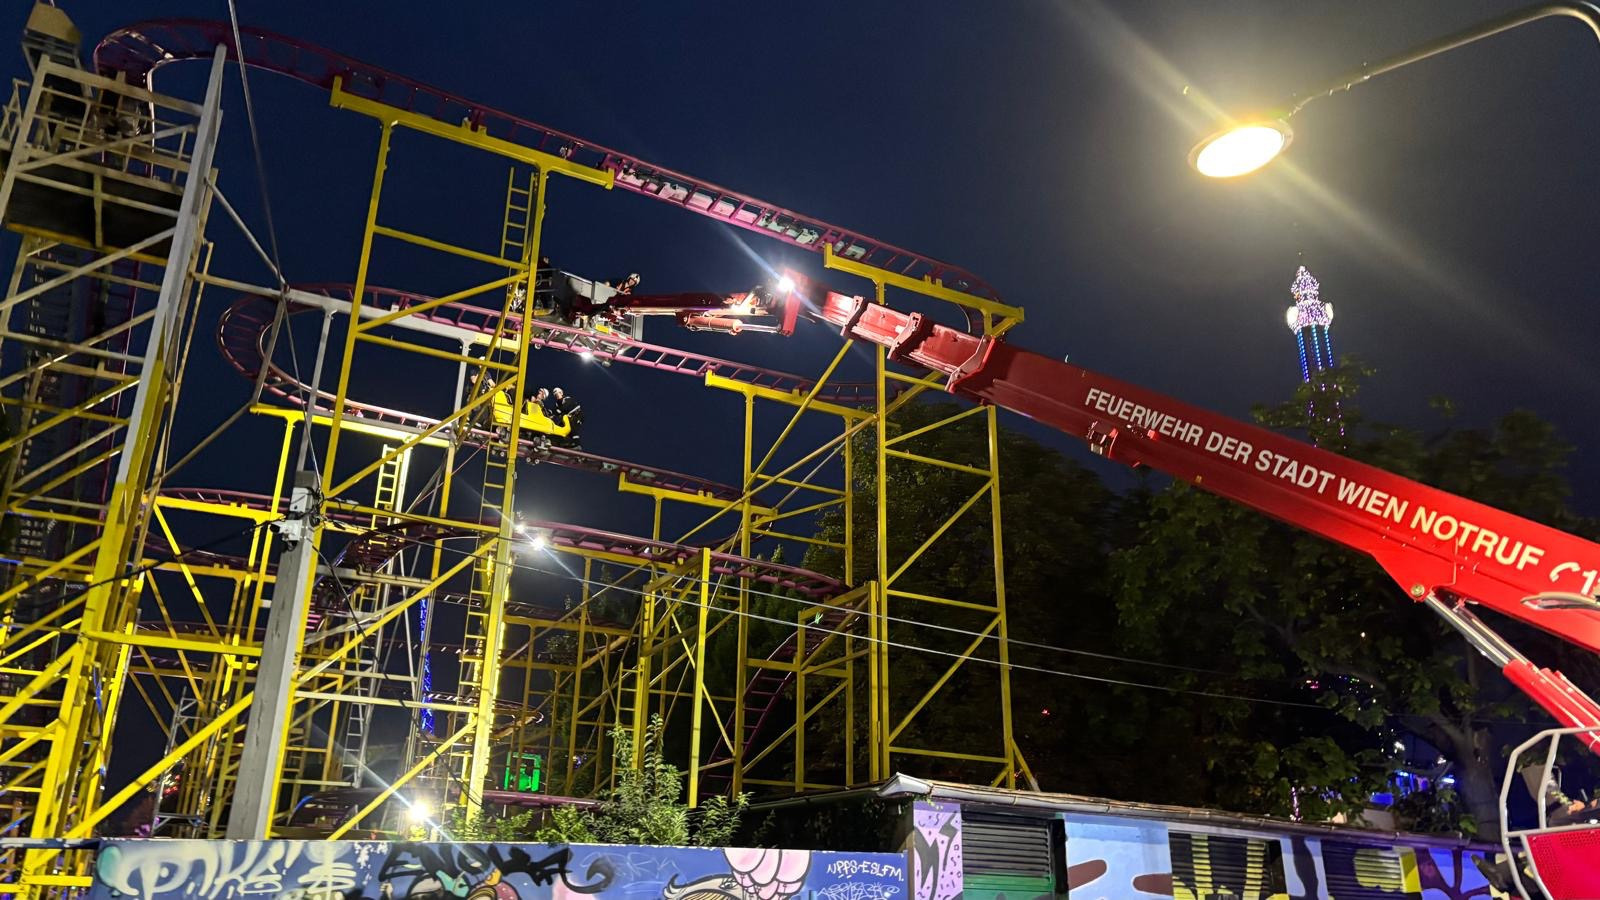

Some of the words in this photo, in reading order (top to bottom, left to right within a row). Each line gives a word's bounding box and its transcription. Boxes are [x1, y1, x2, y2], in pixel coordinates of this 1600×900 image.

[1084, 388, 1204, 446] FEUERWEHR
[1205, 431, 1253, 465] DER
[1254, 449, 1336, 495] STADT
[1337, 477, 1409, 523] WIEN
[1410, 506, 1545, 570] NOTRUF
[1581, 569, 1600, 596] 1
